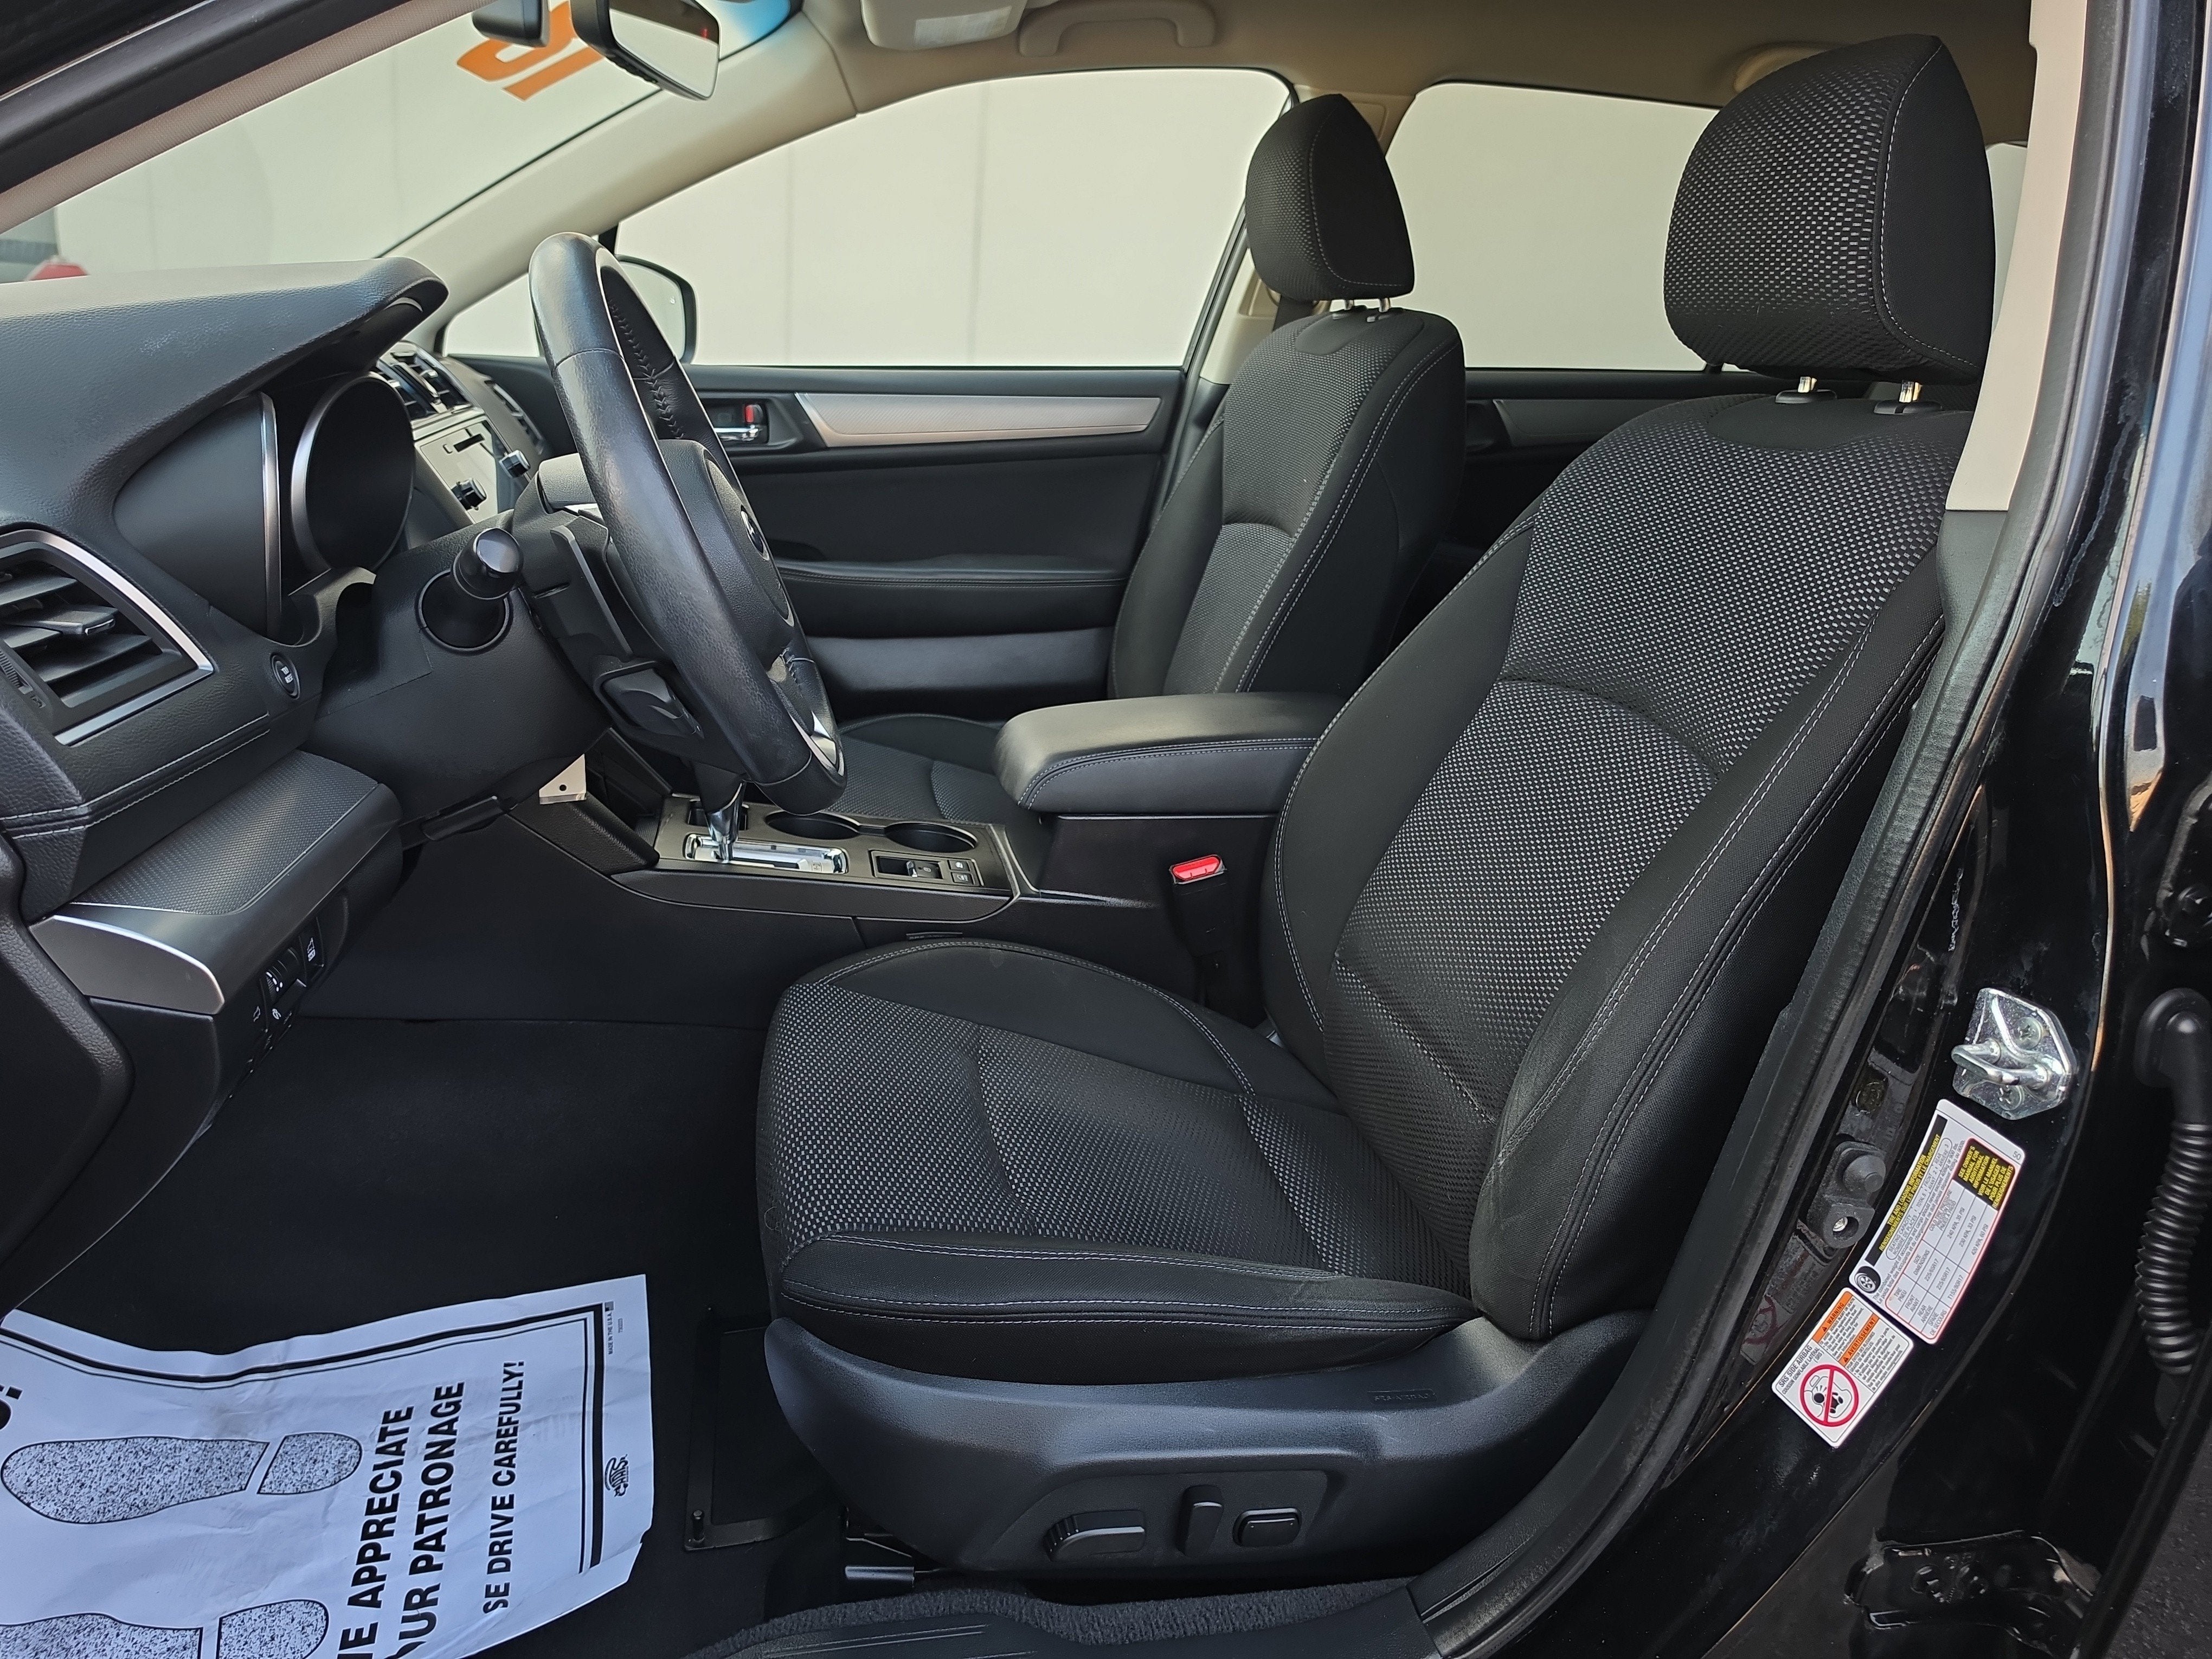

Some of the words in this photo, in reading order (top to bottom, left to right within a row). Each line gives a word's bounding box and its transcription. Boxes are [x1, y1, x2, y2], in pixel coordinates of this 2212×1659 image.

[1923, 1133, 1940, 1166] CHARGEMENT
[1933, 1152, 1941, 1165] REAR
[1958, 1167, 1966, 1178] SEE
[1962, 1144, 1975, 1169] OWNER'S
[2012, 1151, 2021, 1160] 50
[1917, 1171, 1924, 1179] ET
[1920, 1164, 1927, 1172] LE
[1962, 1160, 1975, 1182] MANUAL
[1971, 1149, 1979, 1161] FOR
[1968, 1153, 1984, 1184] ADDITIONAL
[1972, 1154, 1990, 1189] INFORMATION
[1985, 1156, 1998, 1178] MANUEL
[1987, 1163, 2001, 1189] L'USAGER
[1887, 1213, 1896, 1226] TIRE
[1892, 1204, 1901, 1216] AND
[1898, 1184, 1912, 1206] LOADING
[1908, 1153, 1926, 1186] INFORMATION
[1909, 1177, 1921, 1194] PNEUS
[1923, 1172, 1932, 1187] FRONT
[1927, 1176, 1936, 1189] AVANT
[1977, 1182, 1986, 1196] VOIR
[1983, 1176, 1989, 1185] LE
[1984, 1187, 1991, 1196] DE
[1989, 1186, 1998, 1201] POUR
[1995, 1173, 2003, 1187] PLUS
[2000, 1165, 2007, 1174] DE
[1992, 1165, 2014, 1208] RENSEIGNEMENTS
[1900, 1201, 1908, 1212] SUR
[1905, 1192, 1913, 1203] LES
[1915, 1195, 1924, 1208] TOTAL
[1928, 1219, 1938, 1232] COLD
[1934, 1209, 1943, 1220] TIRE
[1939, 1188, 1952, 1211] PRESSURE
[1877, 1273, 1891, 1293] combined
[1888, 1259, 1900, 1275] weight
[1899, 1235, 1913, 1257] occupants
[1914, 1216, 1924, 1229] cargo
[1920, 1202, 1930, 1217] should
[1933, 1176, 1943, 1192] exceed
[1878, 1211, 1904, 1251] RENSEIGNEMENTS
[1888, 1233, 1900, 1252] SEATING
[1898, 1213, 1912, 1235] CAPACITY
[1892, 1236, 1905, 1255] NOMBRE
[1905, 1214, 1917, 1231] PLACES
[1946, 1229, 1954, 1239] 240
[1956, 1213, 1962, 1221] 35
[1967, 1221, 1973, 1230] 33
[1979, 1230, 1985, 1238] 60
[1880, 1287, 1889, 1299] poids
[1886, 1277, 1894, 1288] total
[1896, 1250, 1911, 1272] occupants
[1913, 1217, 1930, 1242] chargement
[1933, 1189, 1943, 1206] jamais
[1912, 1249, 1930, 1276] DIMENSIONS
[1913, 1253, 1921, 1265] SIZE
[1924, 1257, 1939, 1282] 225/65R17
[1935, 1266, 1951, 1290] 225/65R17
[1947, 1274, 1964, 1300] T155/80R17
[1893, 1286, 1902, 1298] TIRE
[1897, 1289, 1907, 1302] PNEU
[1904, 1294, 1915, 1309] FRONT
[1826, 1301, 1844, 1325] WARNING
[1909, 1297, 1920, 1313] AVANT
[1917, 1304, 1926, 1317] REAR
[1836, 1315, 1848, 1329] against
[1843, 1315, 1853, 1327] covers
[1927, 1311, 1939, 1326] SPARE
[1929, 1327, 1937, 1336] DE
[1933, 1309, 1947, 1329] SECOURS
[1836, 1338, 1847, 1351] owner's
[1844, 1326, 1855, 1339] manual
[1847, 1317, 1876, 1356] AVERTISSEMENT
[1778, 1375, 1789, 1387] SRS
[1786, 1363, 1798, 1377] SIDE
[1795, 1344, 1812, 1366] AIRBAG
[1781, 1378, 1795, 1395] COUSSIN
[1792, 1360, 1809, 1381] GONFLABLE
[493, 1361, 524, 1486] CAREFULLY!
[409, 1382, 465, 1575] PATRONAGE
[348, 1405, 414, 1608] APPRECIATE
[487, 1494, 515, 1574] DRIVE
[337, 1622, 378, 1659] E
